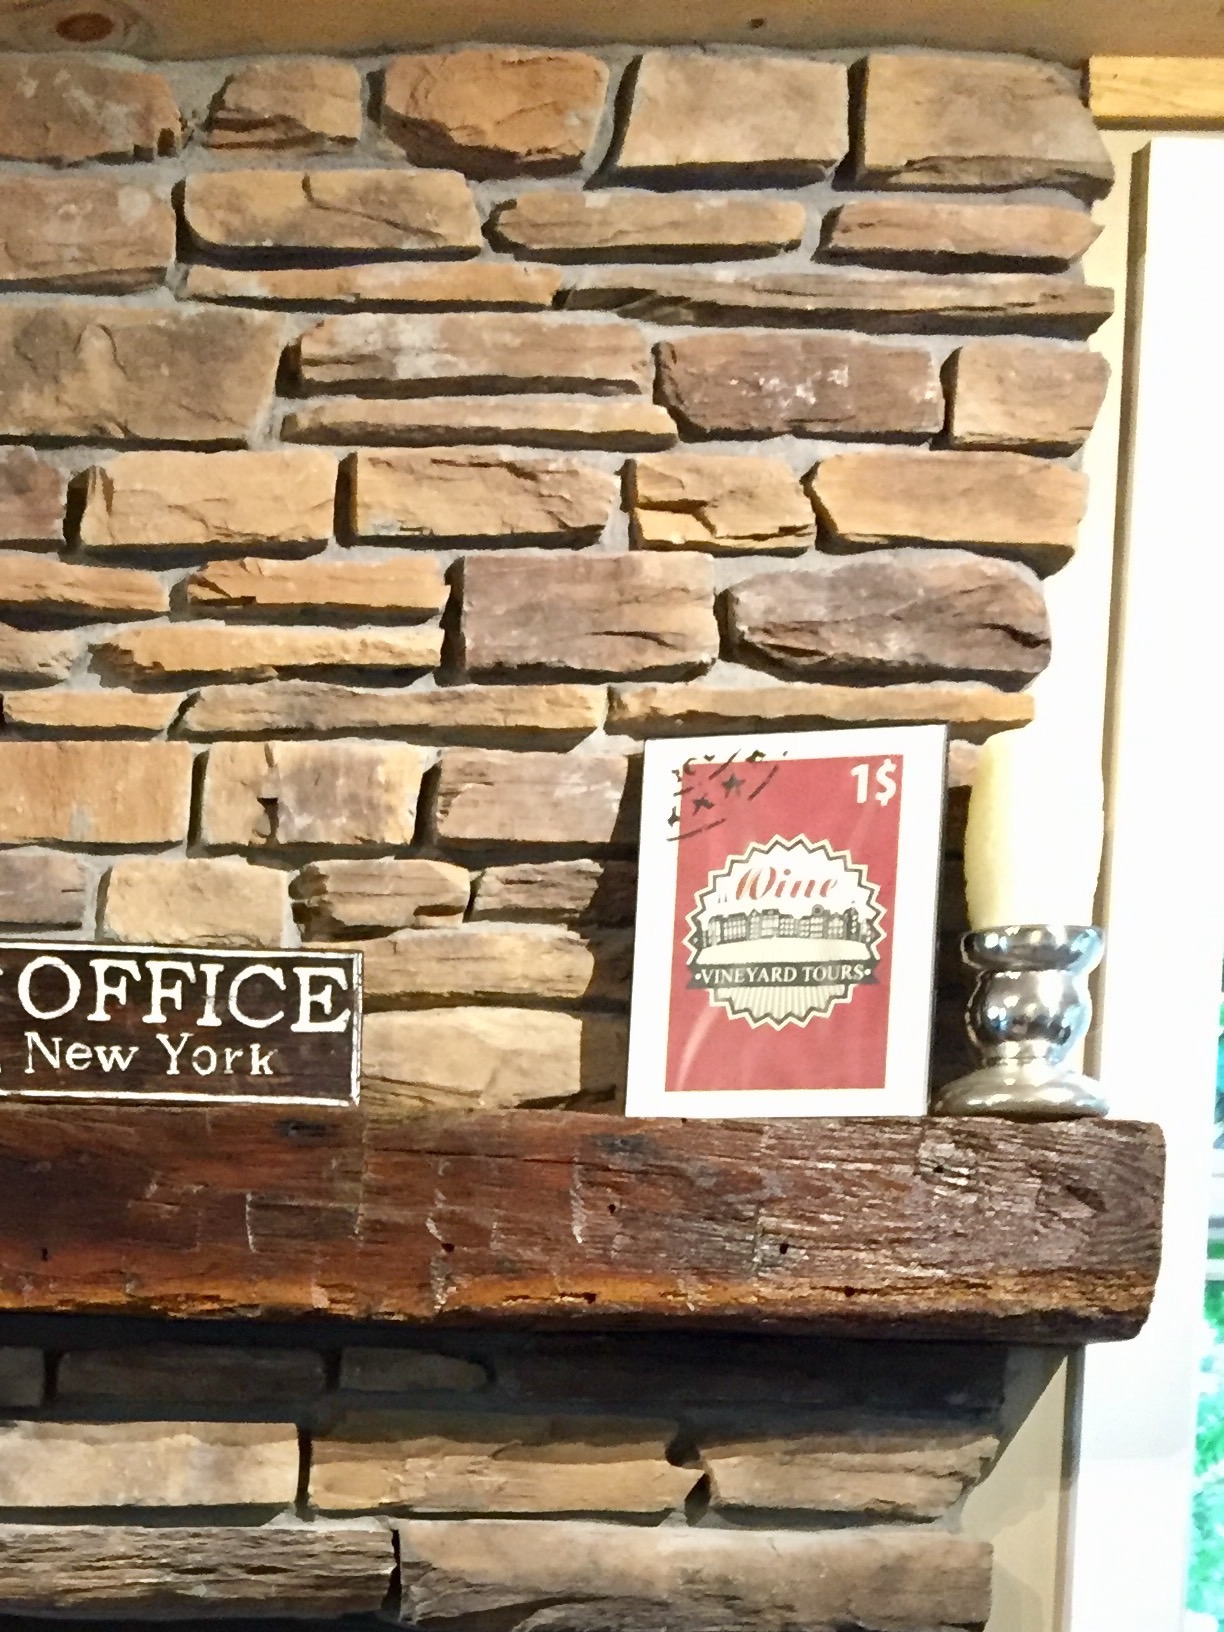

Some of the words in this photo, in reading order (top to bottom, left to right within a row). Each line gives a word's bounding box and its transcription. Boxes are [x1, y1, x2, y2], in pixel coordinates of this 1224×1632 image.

[850, 759, 897, 806] 1$
[735, 865, 838, 901] Wine
[17, 955, 352, 1033] OFFICE
[701, 966, 797, 985] VINEYARD
[802, 964, 864, 983] TOURS
[24, 1030, 140, 1075] New
[156, 1033, 276, 1076] York
